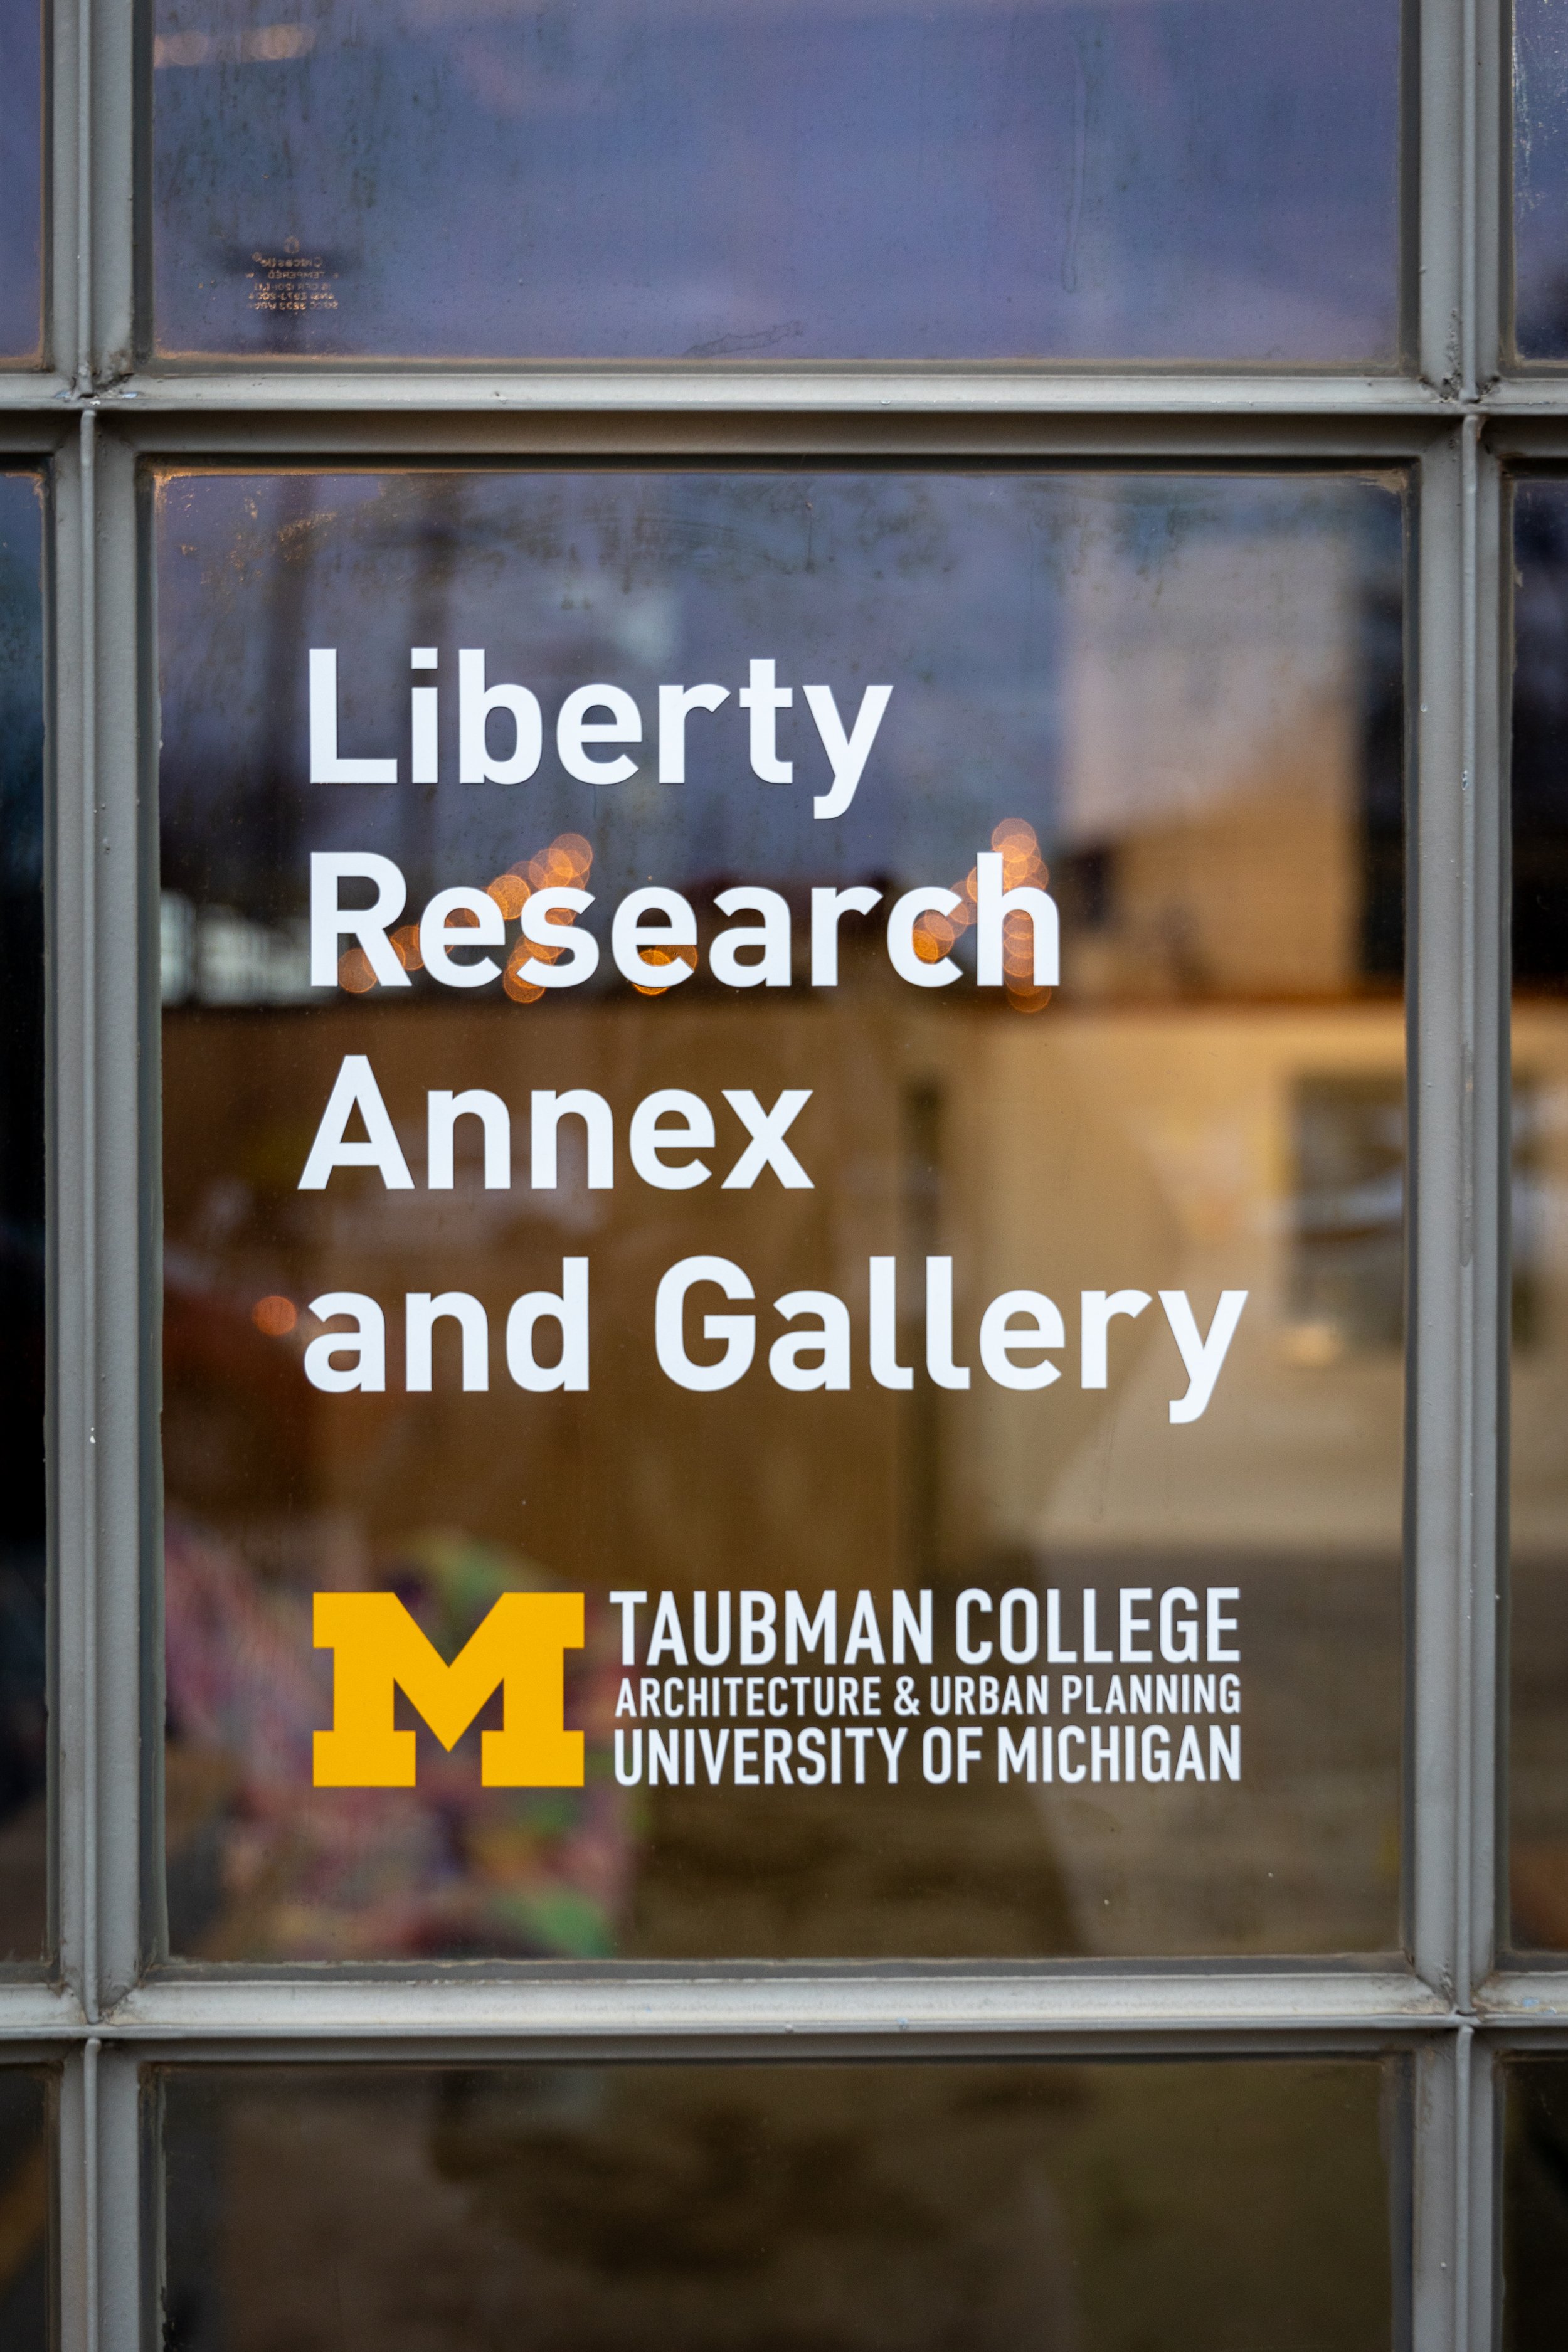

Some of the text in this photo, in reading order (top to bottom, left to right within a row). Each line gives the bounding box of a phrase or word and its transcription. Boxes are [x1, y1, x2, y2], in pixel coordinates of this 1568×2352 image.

[309, 647, 894, 820] Liberty
[310, 851, 1060, 988] Research
[298, 1055, 814, 1190] Annex
[304, 1256, 1249, 1424] and Gallery
[313, 1592, 585, 1787] M
[610, 1587, 1240, 1666] TAUBMAN COLLEGE
[615, 1673, 1241, 1717] ARCHITECTURE & URBAN PLANNING
[615, 1725, 1241, 1786] UNIVERSITY OF MICHIGAN
